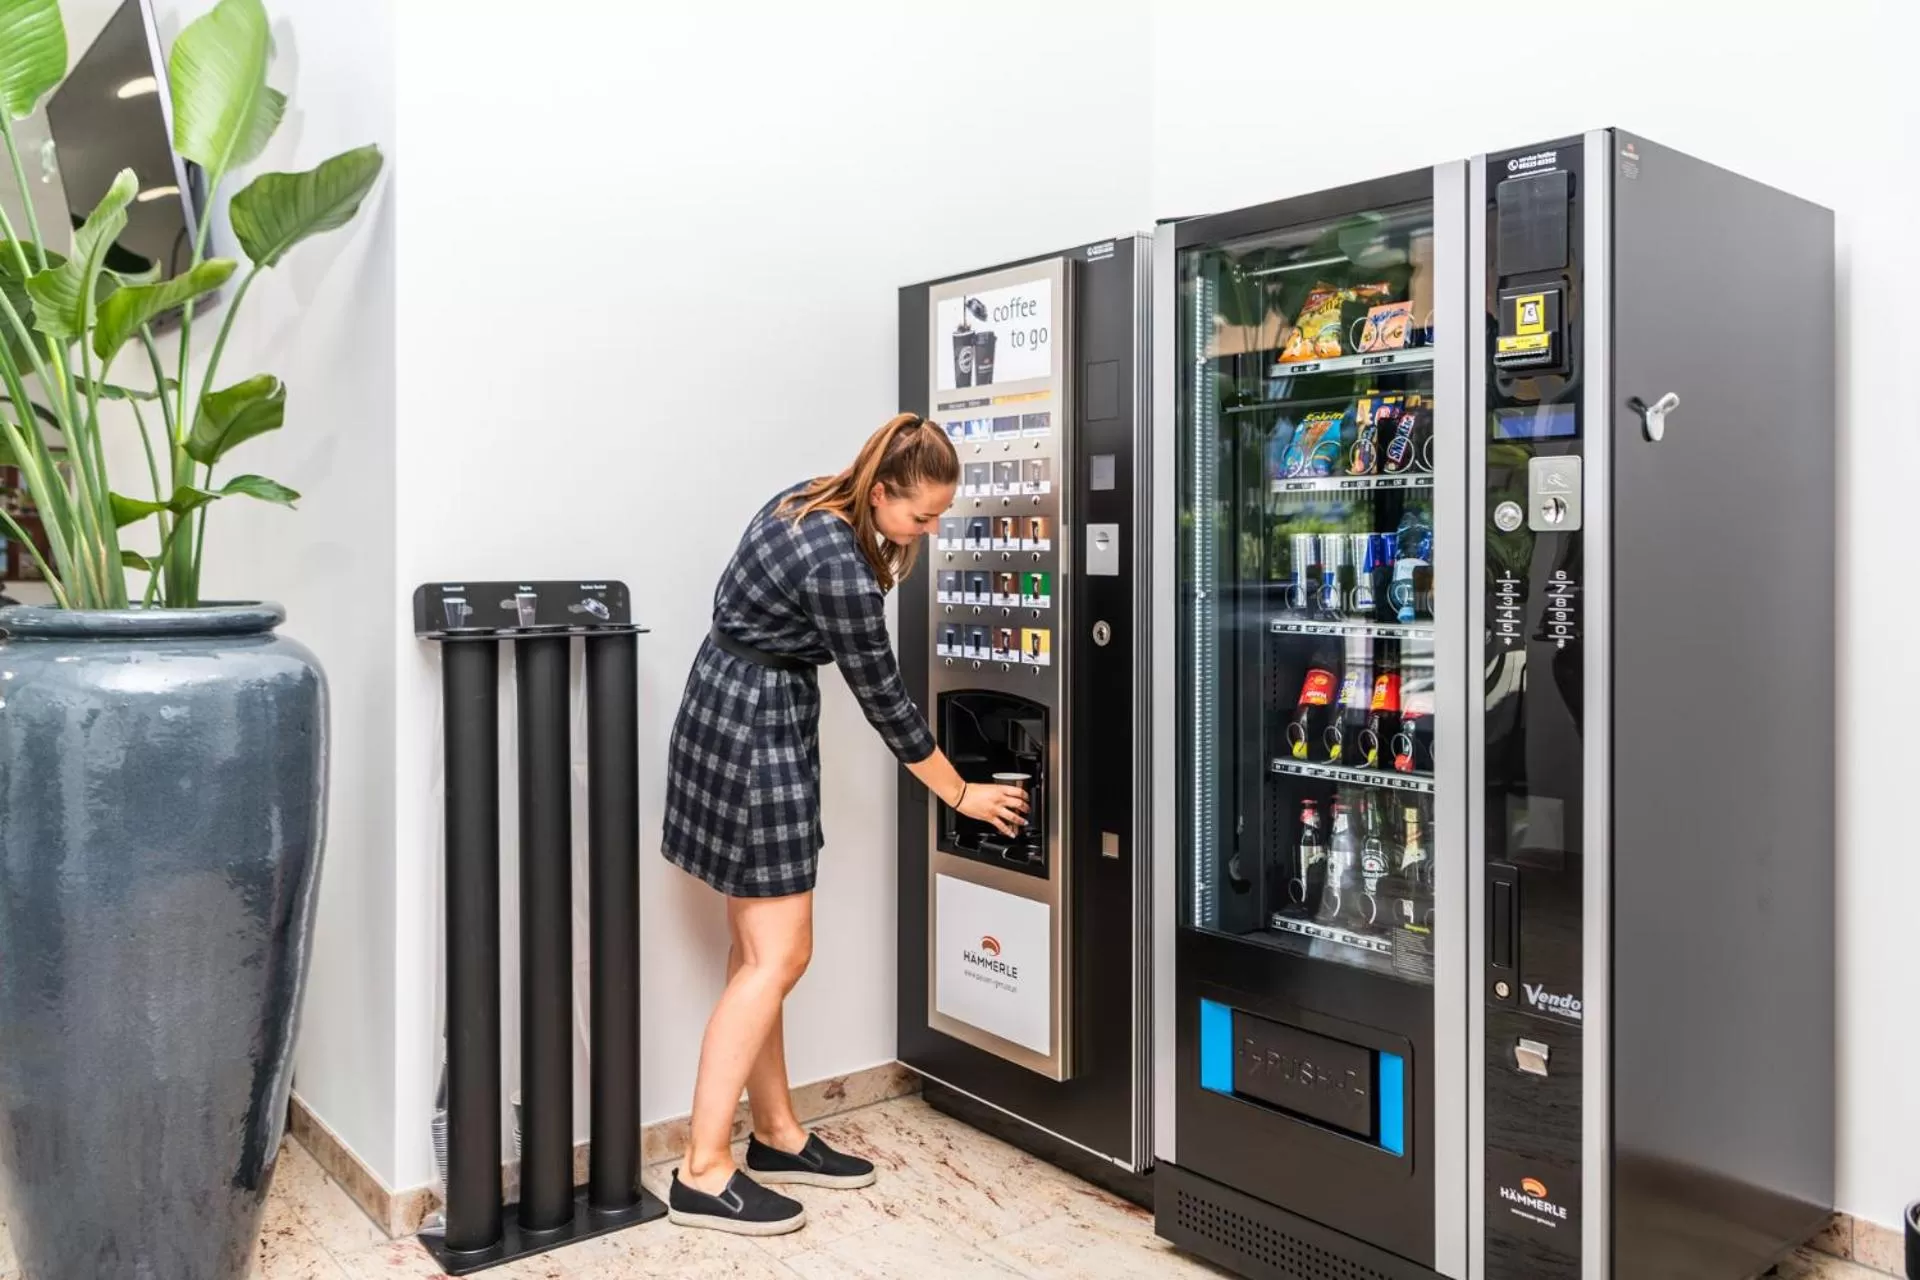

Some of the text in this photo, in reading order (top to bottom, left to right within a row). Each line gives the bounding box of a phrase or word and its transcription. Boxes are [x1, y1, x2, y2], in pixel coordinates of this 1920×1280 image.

[993, 296, 1037, 323] coffee
[1010, 327, 1048, 351] to go
[1504, 570, 1511, 579] 1
[1555, 570, 1567, 580] 6
[1502, 583, 1513, 593] 2
[1555, 584, 1567, 594] 7
[1502, 597, 1513, 606] 3
[1555, 598, 1567, 608] 8
[1503, 610, 1513, 619] 4
[1555, 612, 1567, 621] 9
[1502, 623, 1513, 632] 5
[1555, 625, 1567, 635] 0
[963, 949, 1018, 979] HÄMMERLE
[1522, 983, 1582, 1011] Vendo
[1499, 1186, 1568, 1220] HÄMMERLE
